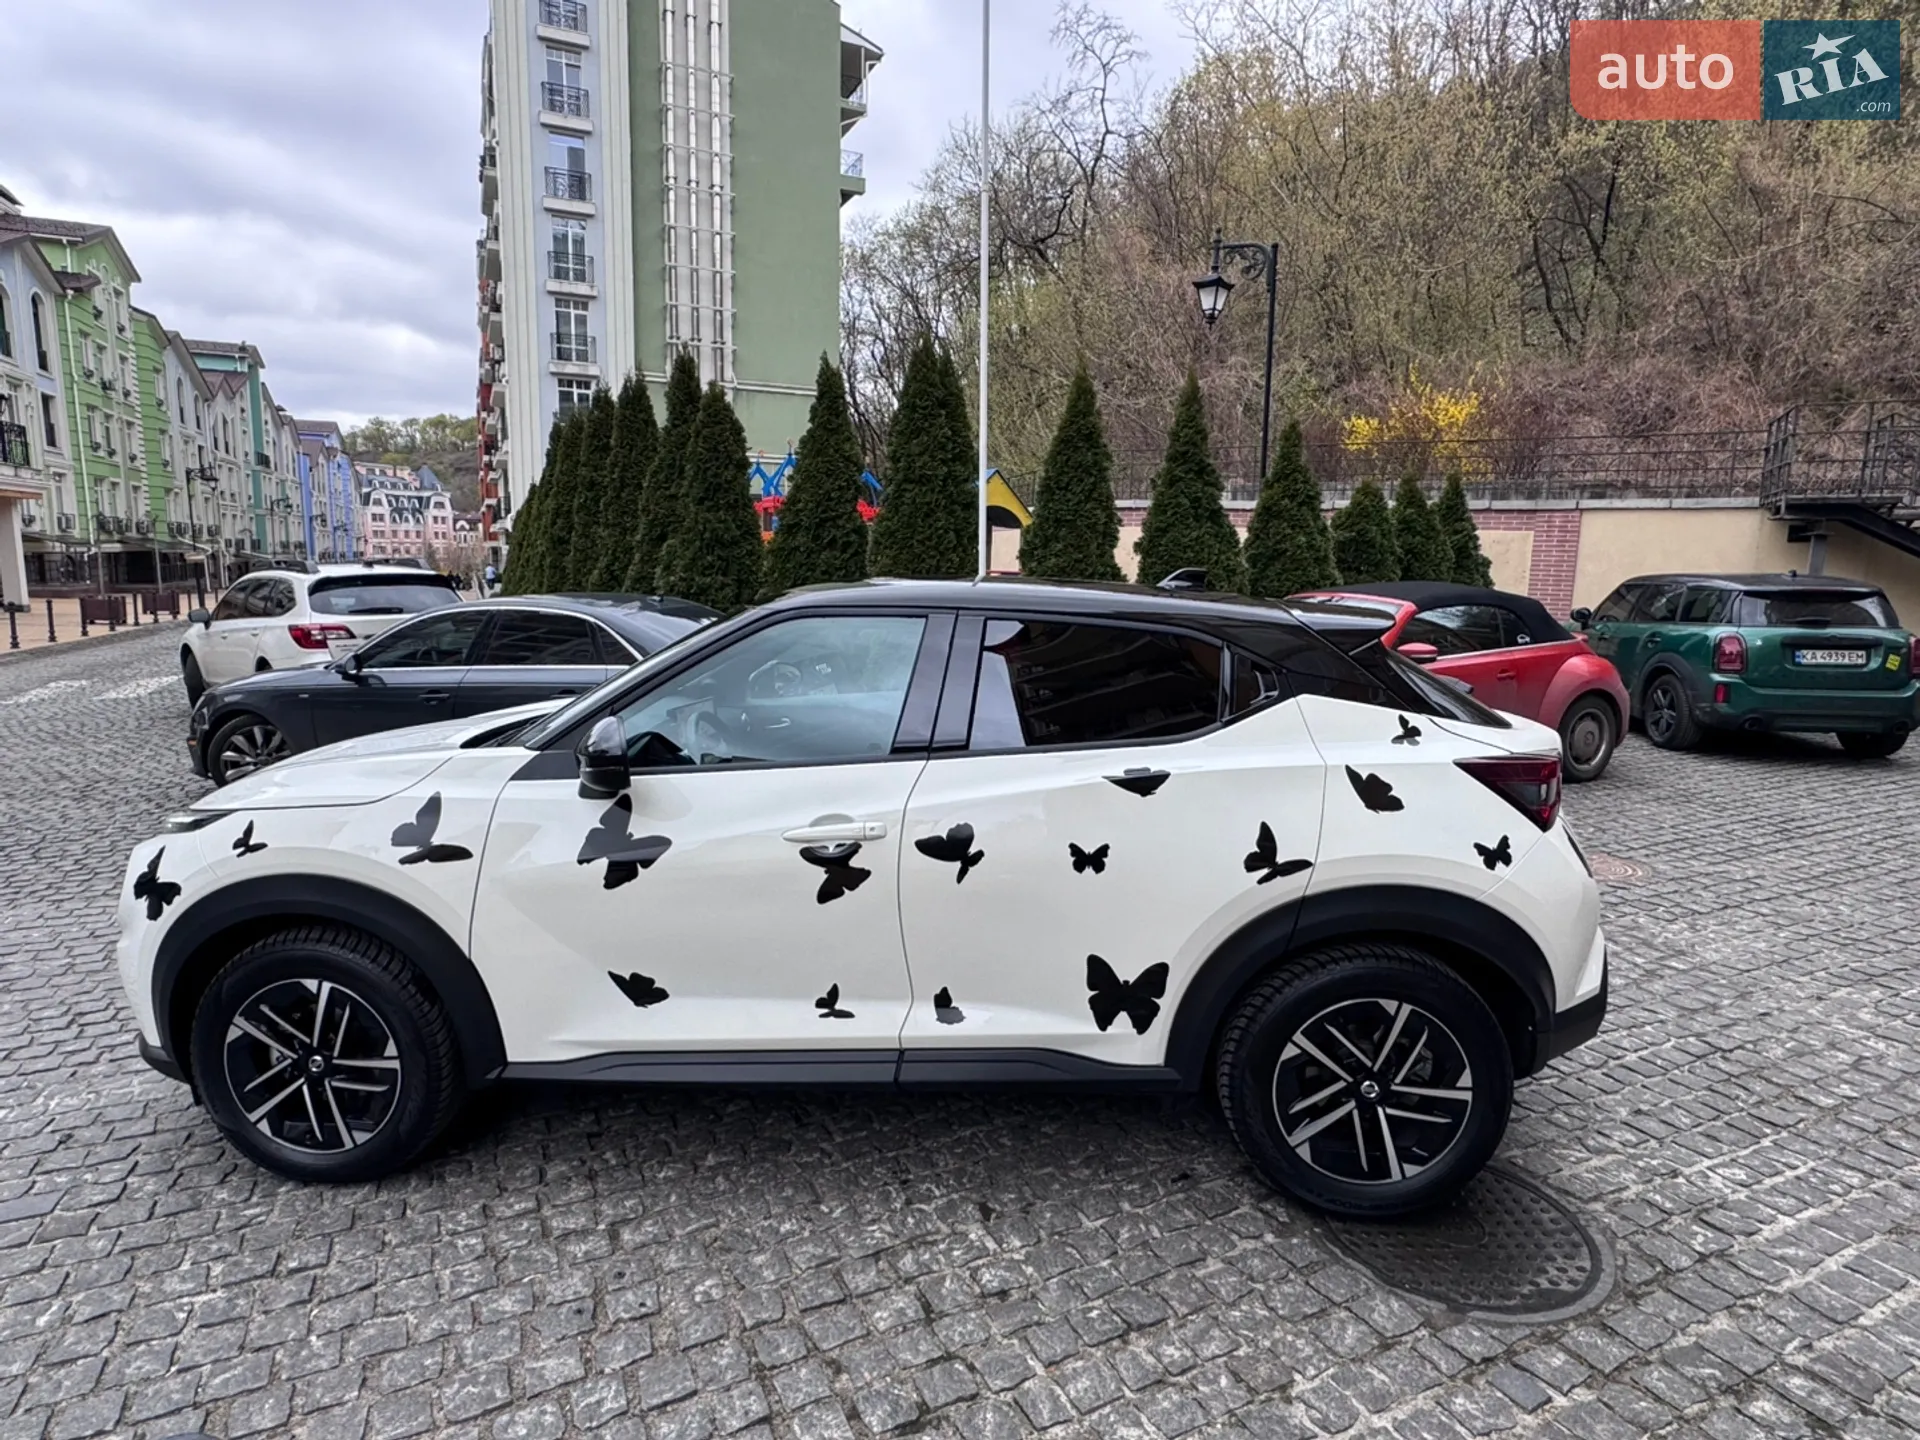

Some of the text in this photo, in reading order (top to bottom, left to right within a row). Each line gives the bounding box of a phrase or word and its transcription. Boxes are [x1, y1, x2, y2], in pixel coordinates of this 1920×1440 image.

[1801, 650, 1865, 661] KA 4939 EM
